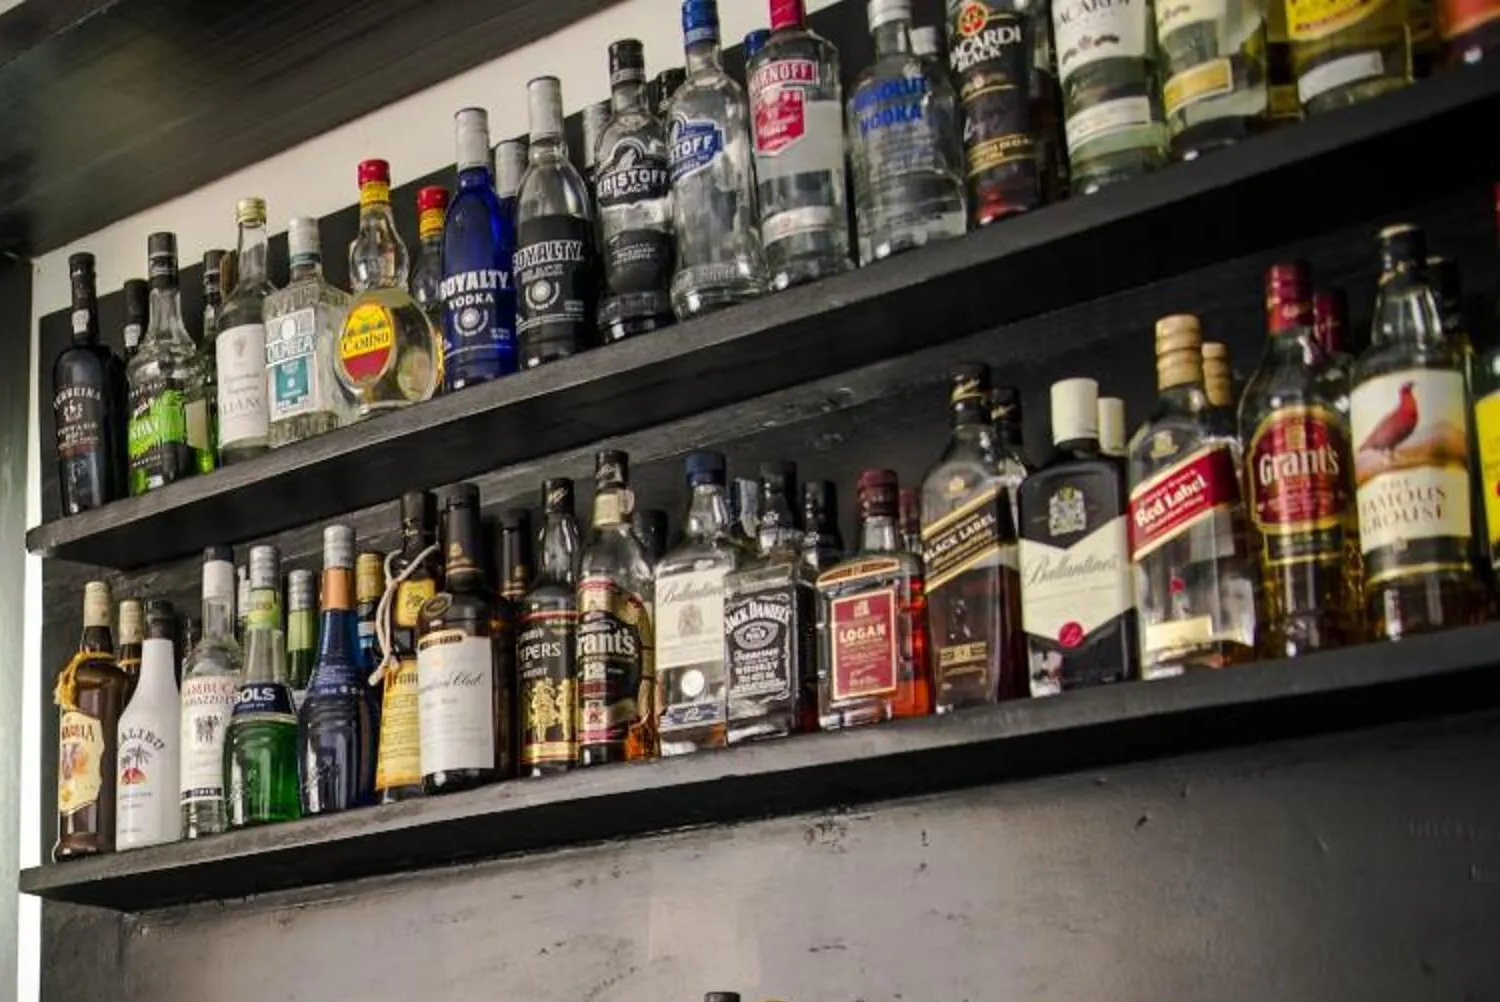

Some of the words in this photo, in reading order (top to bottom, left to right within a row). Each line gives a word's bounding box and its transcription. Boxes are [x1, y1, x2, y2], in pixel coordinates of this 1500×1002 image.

[448, 291, 495, 311] VODKA
[1258, 442, 1341, 487] Grant's
[1135, 497, 1165, 528] Red
[1163, 473, 1208, 509] Label
[838, 622, 887, 643] LOGAN
[120, 727, 166, 751] ALIBU
